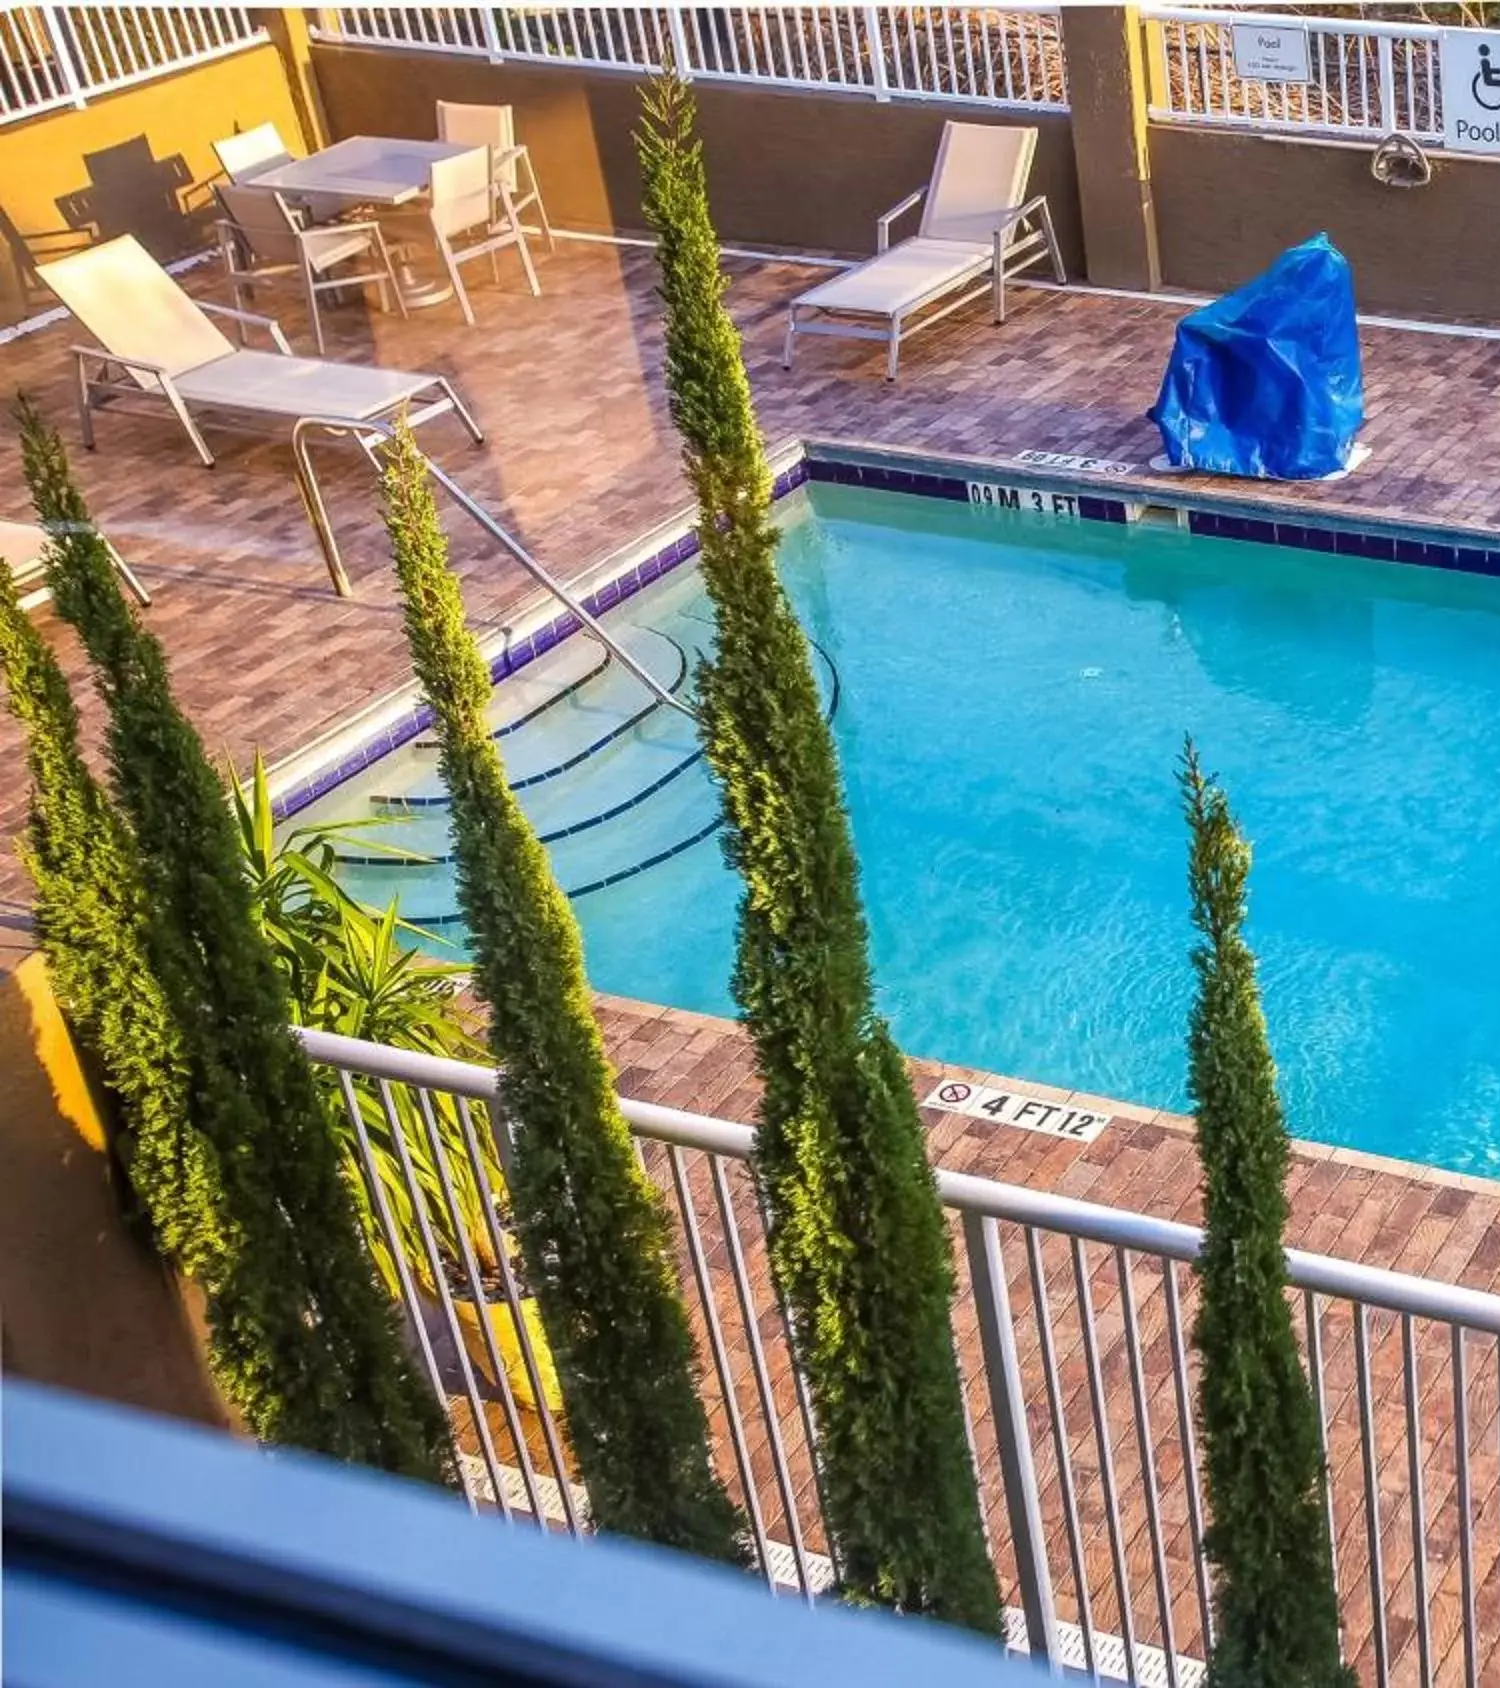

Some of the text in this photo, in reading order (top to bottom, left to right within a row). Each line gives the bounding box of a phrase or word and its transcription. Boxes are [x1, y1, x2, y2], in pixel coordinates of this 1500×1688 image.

[1456, 119, 1500, 142] Pool
[1031, 491, 1044, 513] 3
[1051, 494, 1077, 516] FT
[981, 1095, 1010, 1116] 4
[1013, 1101, 1062, 1127] FT
